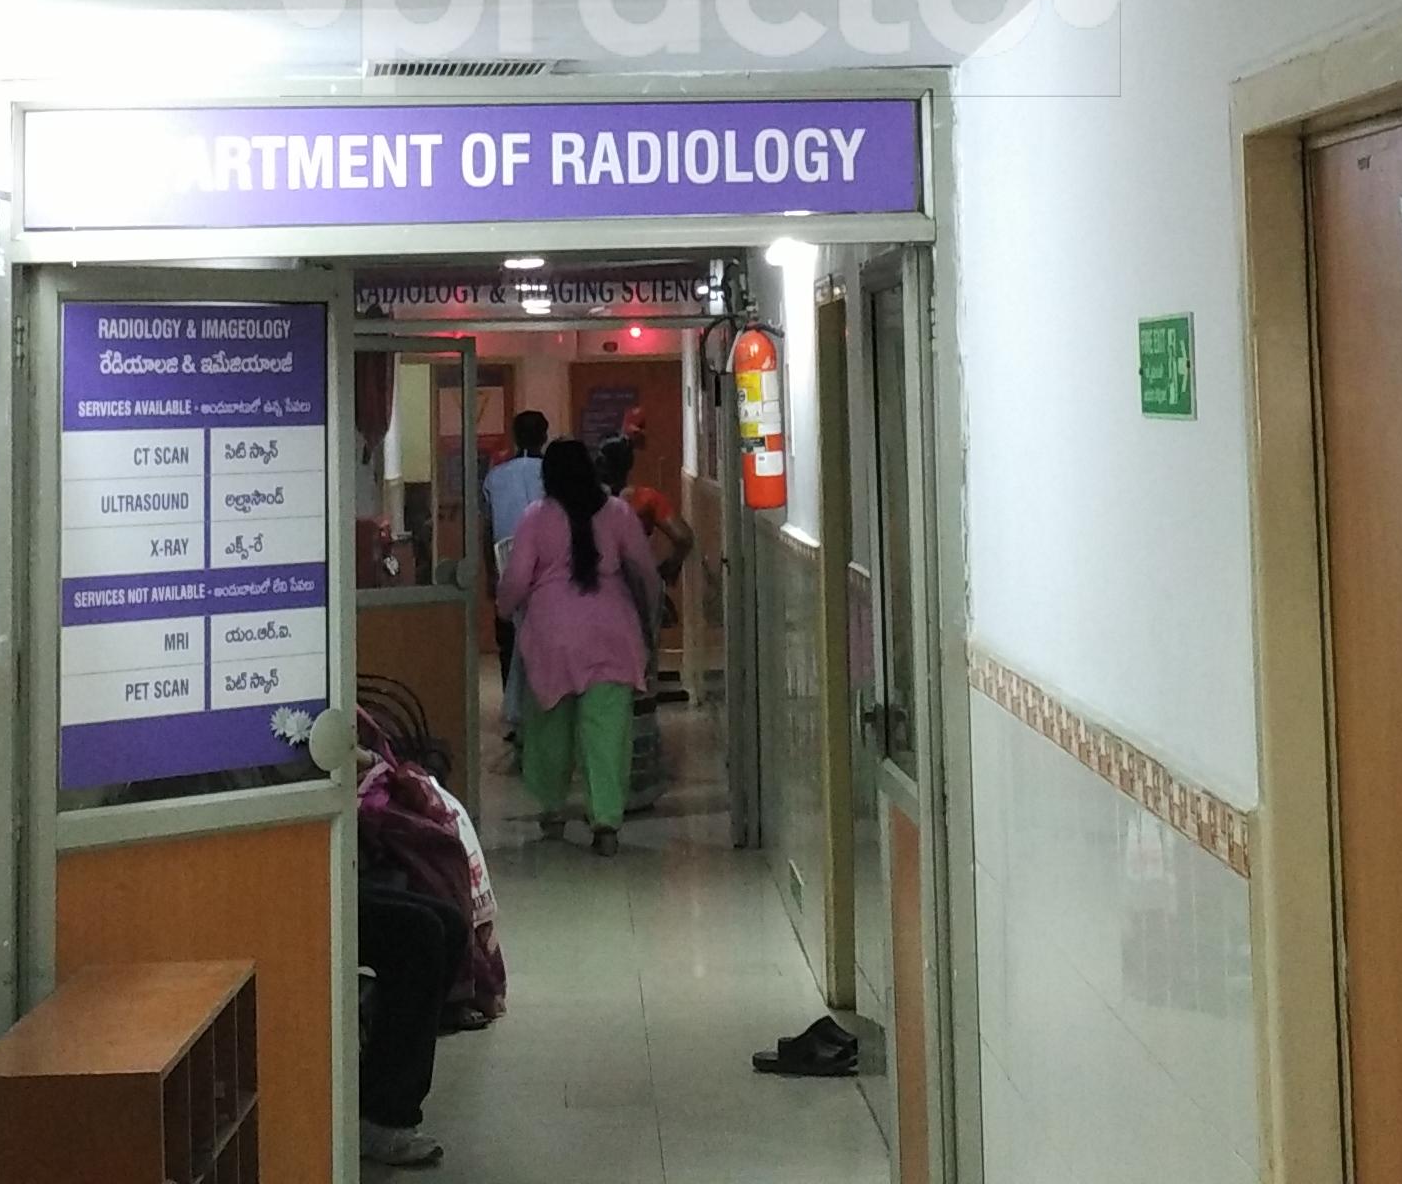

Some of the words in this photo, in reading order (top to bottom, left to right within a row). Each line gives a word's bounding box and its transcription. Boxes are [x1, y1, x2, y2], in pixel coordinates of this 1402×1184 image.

[175, 135, 444, 193] ARTMENT
[461, 132, 531, 188] OF
[551, 127, 866, 186] RADIOLOGY
[489, 283, 506, 304] &
[515, 279, 614, 304] IAGING
[98, 318, 181, 339] RADIOLOGY
[186, 320, 197, 339] &
[201, 319, 291, 339] IMAGEOLOGY
[182, 354, 196, 373] &
[78, 400, 131, 417] SERVICES
[134, 399, 192, 415] AVAILABLE
[133, 447, 150, 466] CT
[154, 447, 189, 465] SCAN
[101, 492, 189, 513] ULTRASOUND
[150, 538, 189, 557] X-RAY
[74, 590, 125, 609] SERVICES
[127, 587, 148, 604] NOT
[151, 583, 205, 601] AVAILABLE
[164, 632, 189, 651] MRI
[125, 682, 149, 702] PET
[154, 679, 189, 698] SCAN
